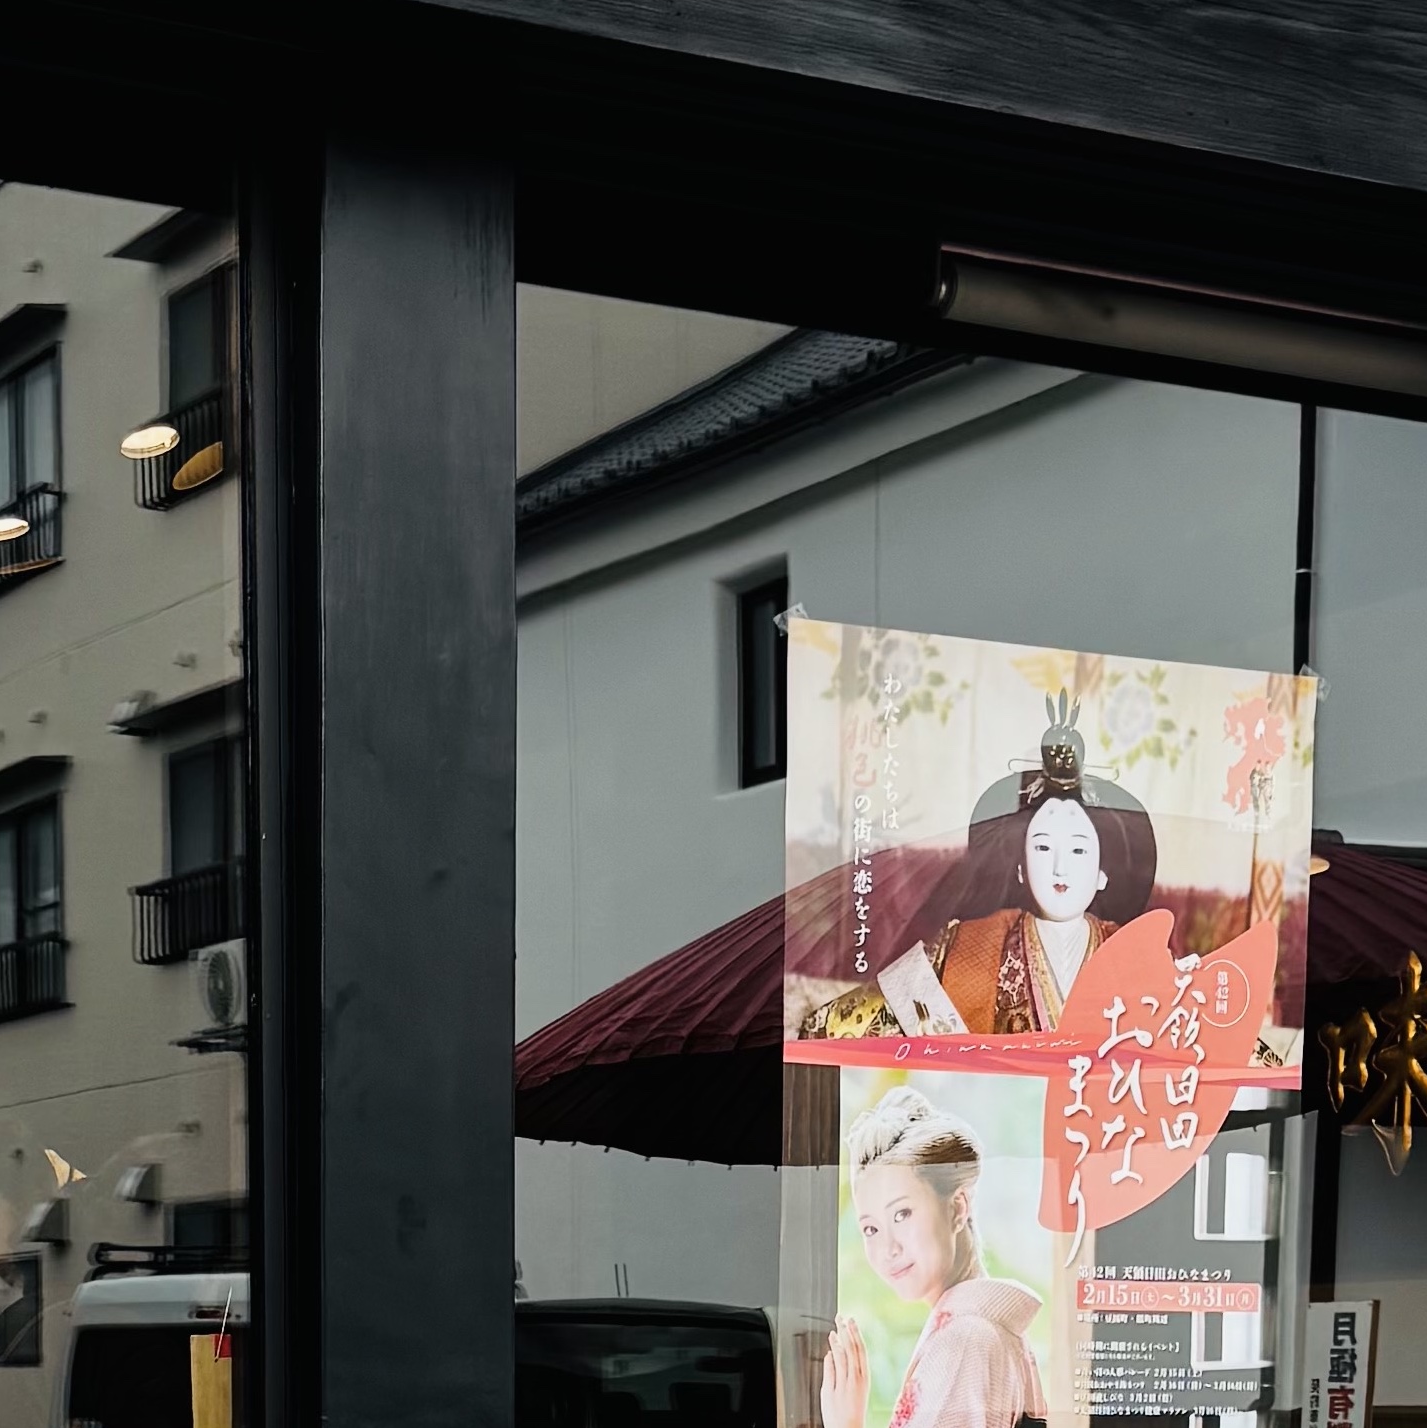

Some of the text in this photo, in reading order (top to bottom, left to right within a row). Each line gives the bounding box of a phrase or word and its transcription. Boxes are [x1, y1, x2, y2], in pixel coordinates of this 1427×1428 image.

[881, 673, 902, 830] わたしたちは
